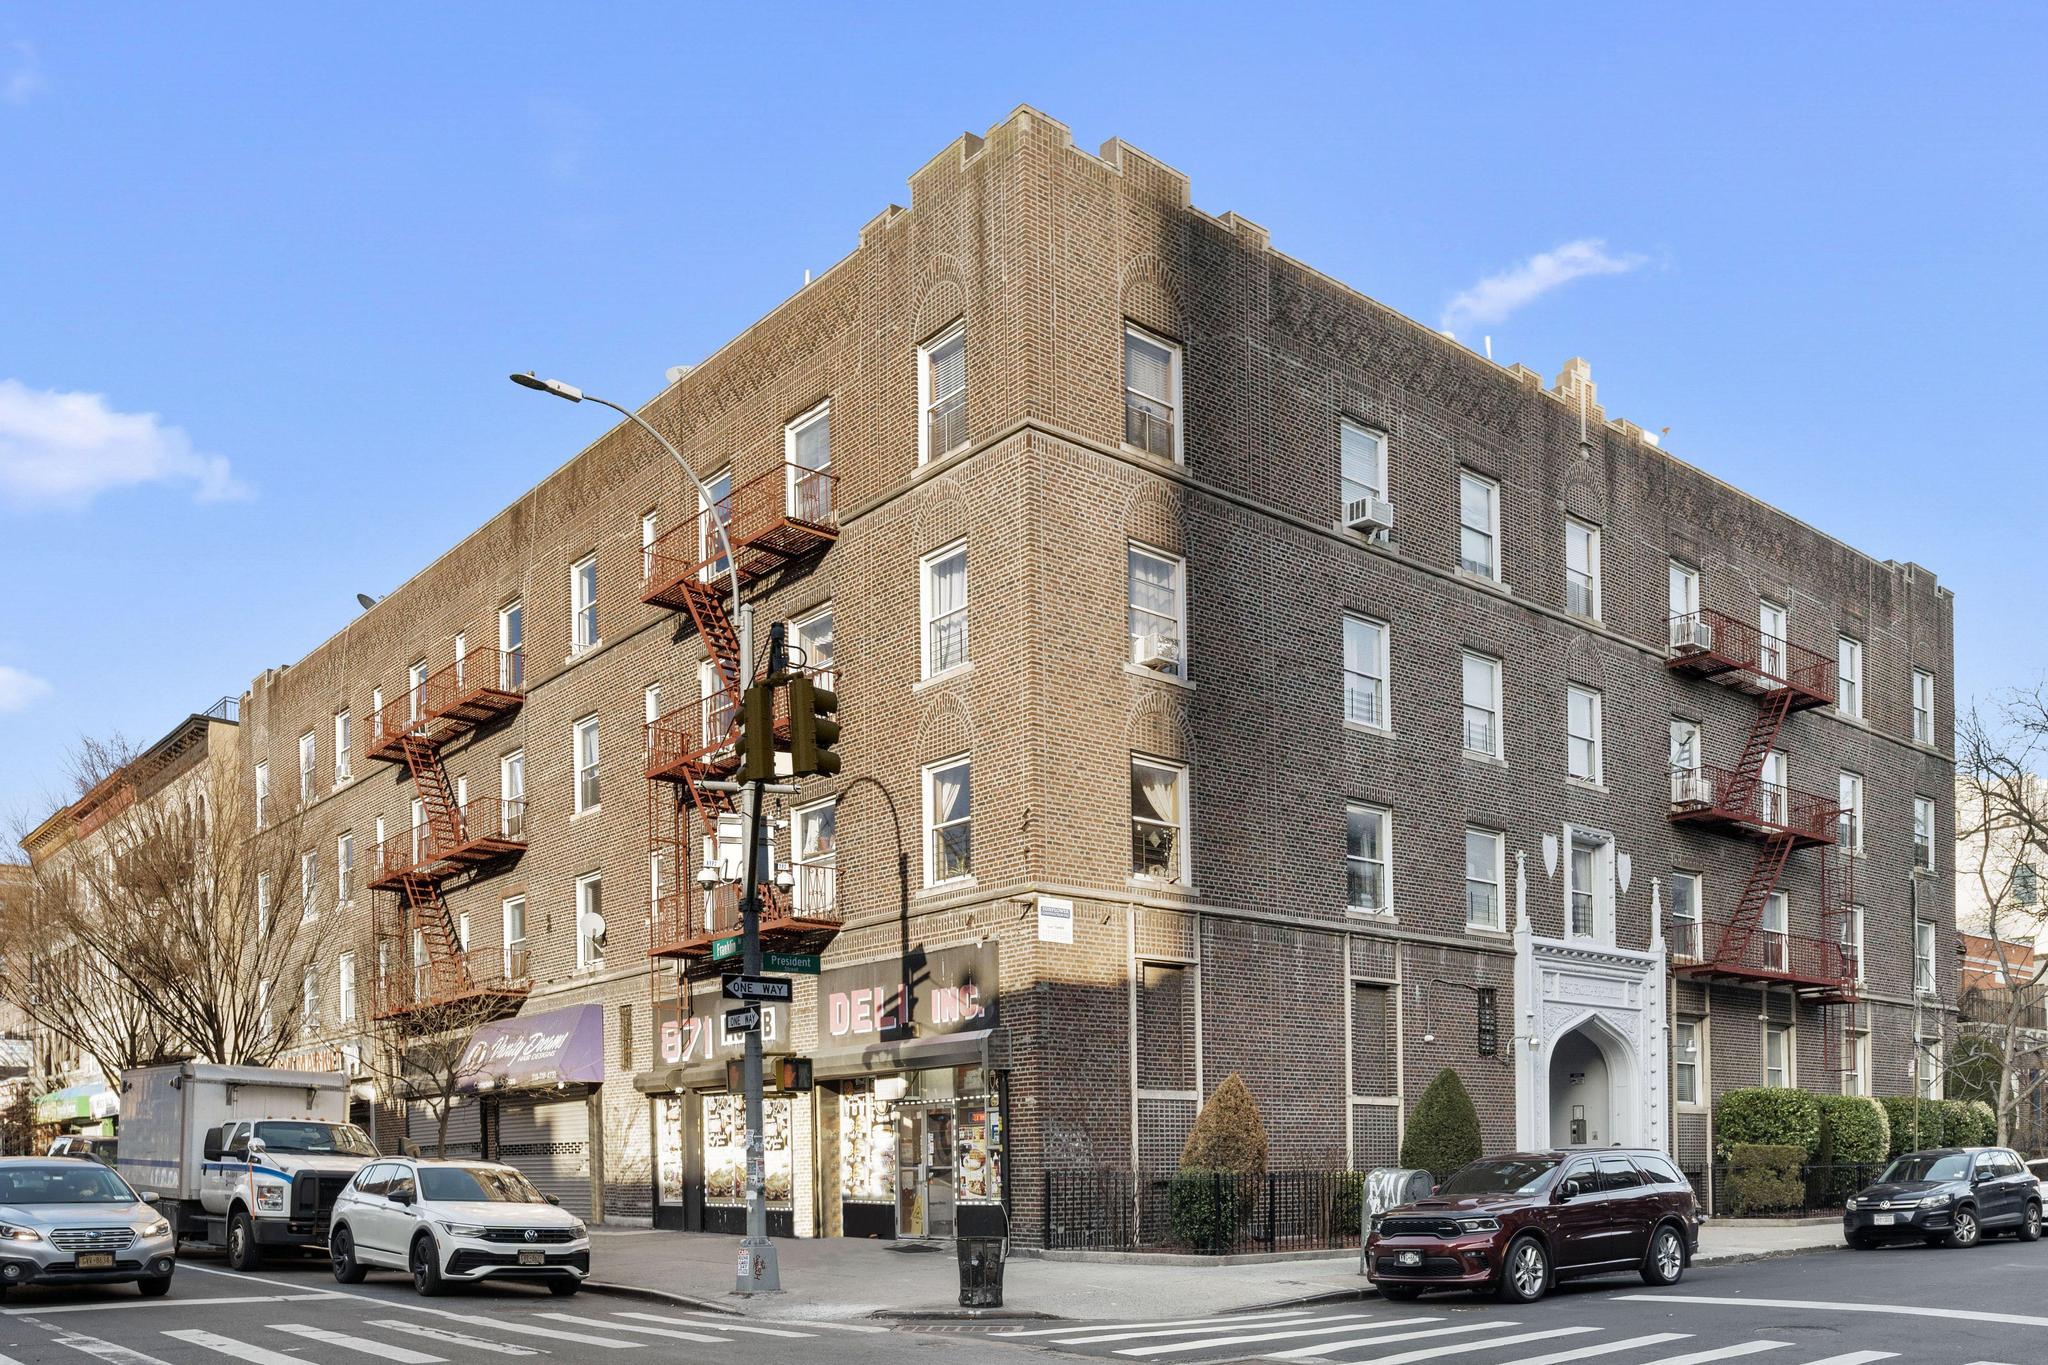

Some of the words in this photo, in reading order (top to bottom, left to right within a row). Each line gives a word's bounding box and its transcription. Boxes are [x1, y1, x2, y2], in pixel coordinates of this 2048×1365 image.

[716, 939, 737, 957] Franklin
[771, 955, 811, 968] President
[733, 983, 753, 993] ONE
[762, 984, 784, 995] WAY
[828, 984, 909, 1036] DELI
[931, 984, 985, 1024] INC.
[730, 1015, 741, 1026] ONE
[744, 1013, 756, 1025] WAY
[661, 1015, 713, 1064] 871
